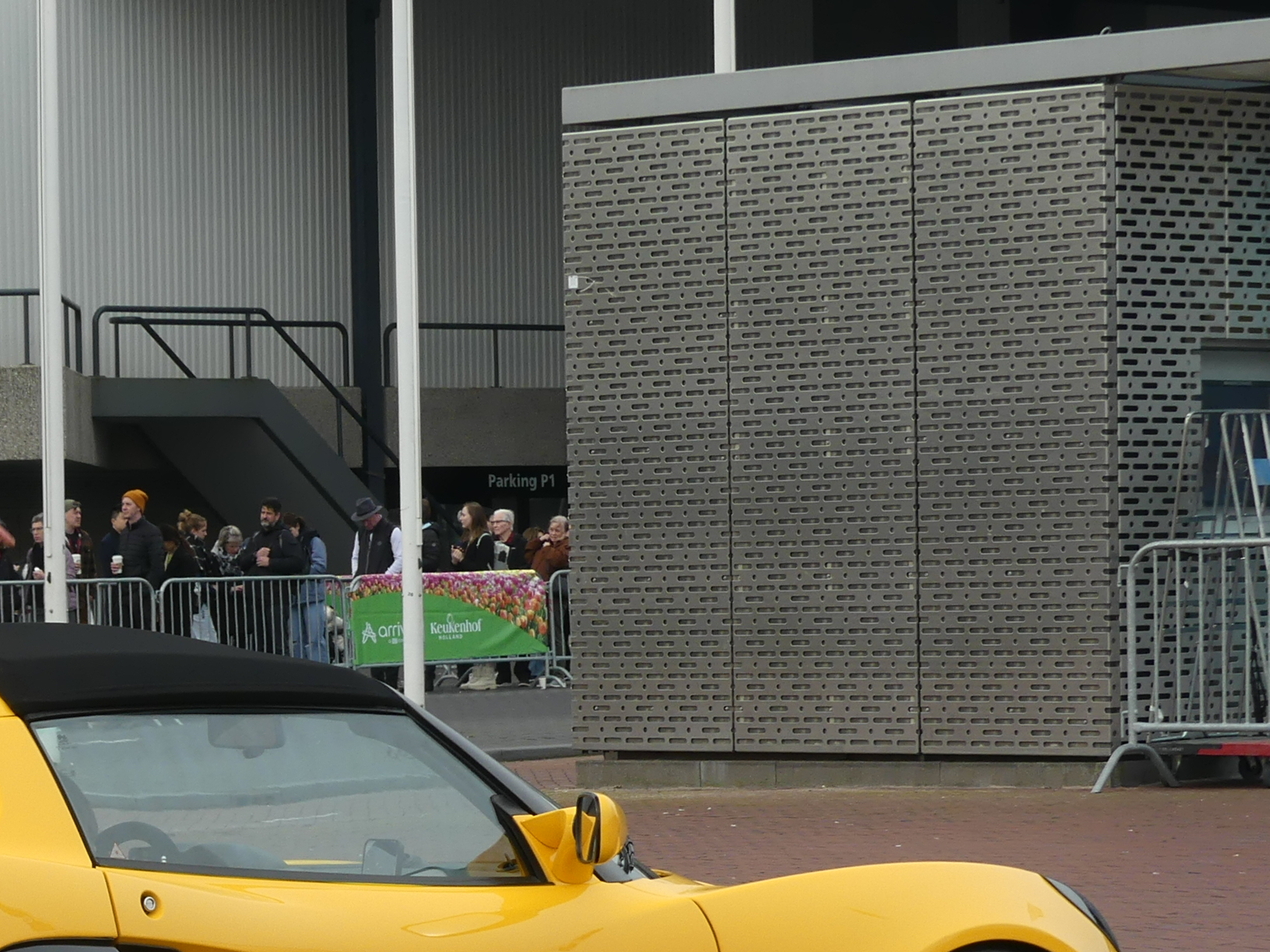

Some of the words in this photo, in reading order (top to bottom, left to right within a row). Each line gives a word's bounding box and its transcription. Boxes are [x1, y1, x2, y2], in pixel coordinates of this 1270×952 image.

[488, 473, 537, 491] Parking
[541, 474, 555, 488] P1
[430, 614, 483, 634] Keukenhof
